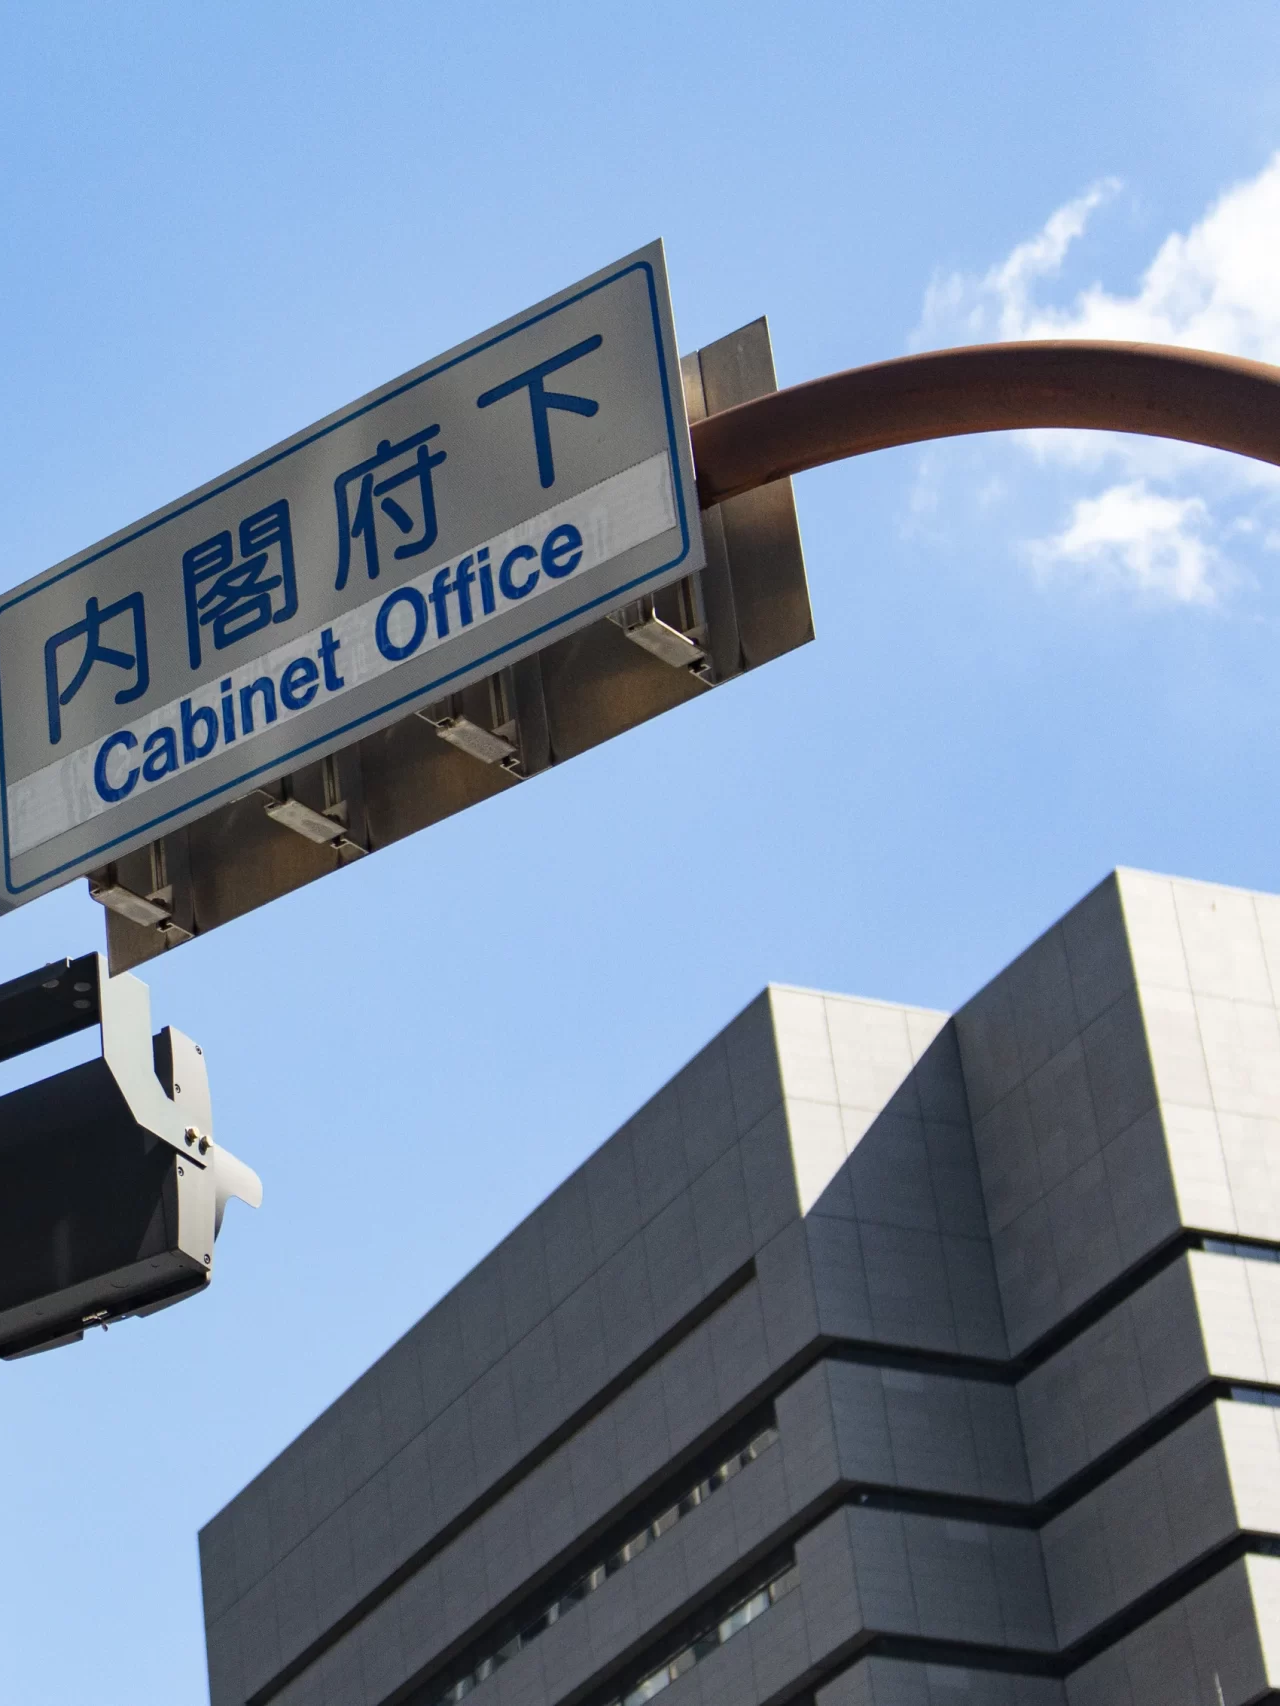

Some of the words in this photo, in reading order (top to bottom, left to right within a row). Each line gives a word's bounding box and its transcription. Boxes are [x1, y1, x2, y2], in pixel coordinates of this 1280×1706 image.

[44, 335, 602, 745] 内閣府下
[92, 627, 345, 803] Cabinet
[374, 523, 584, 662] Office
